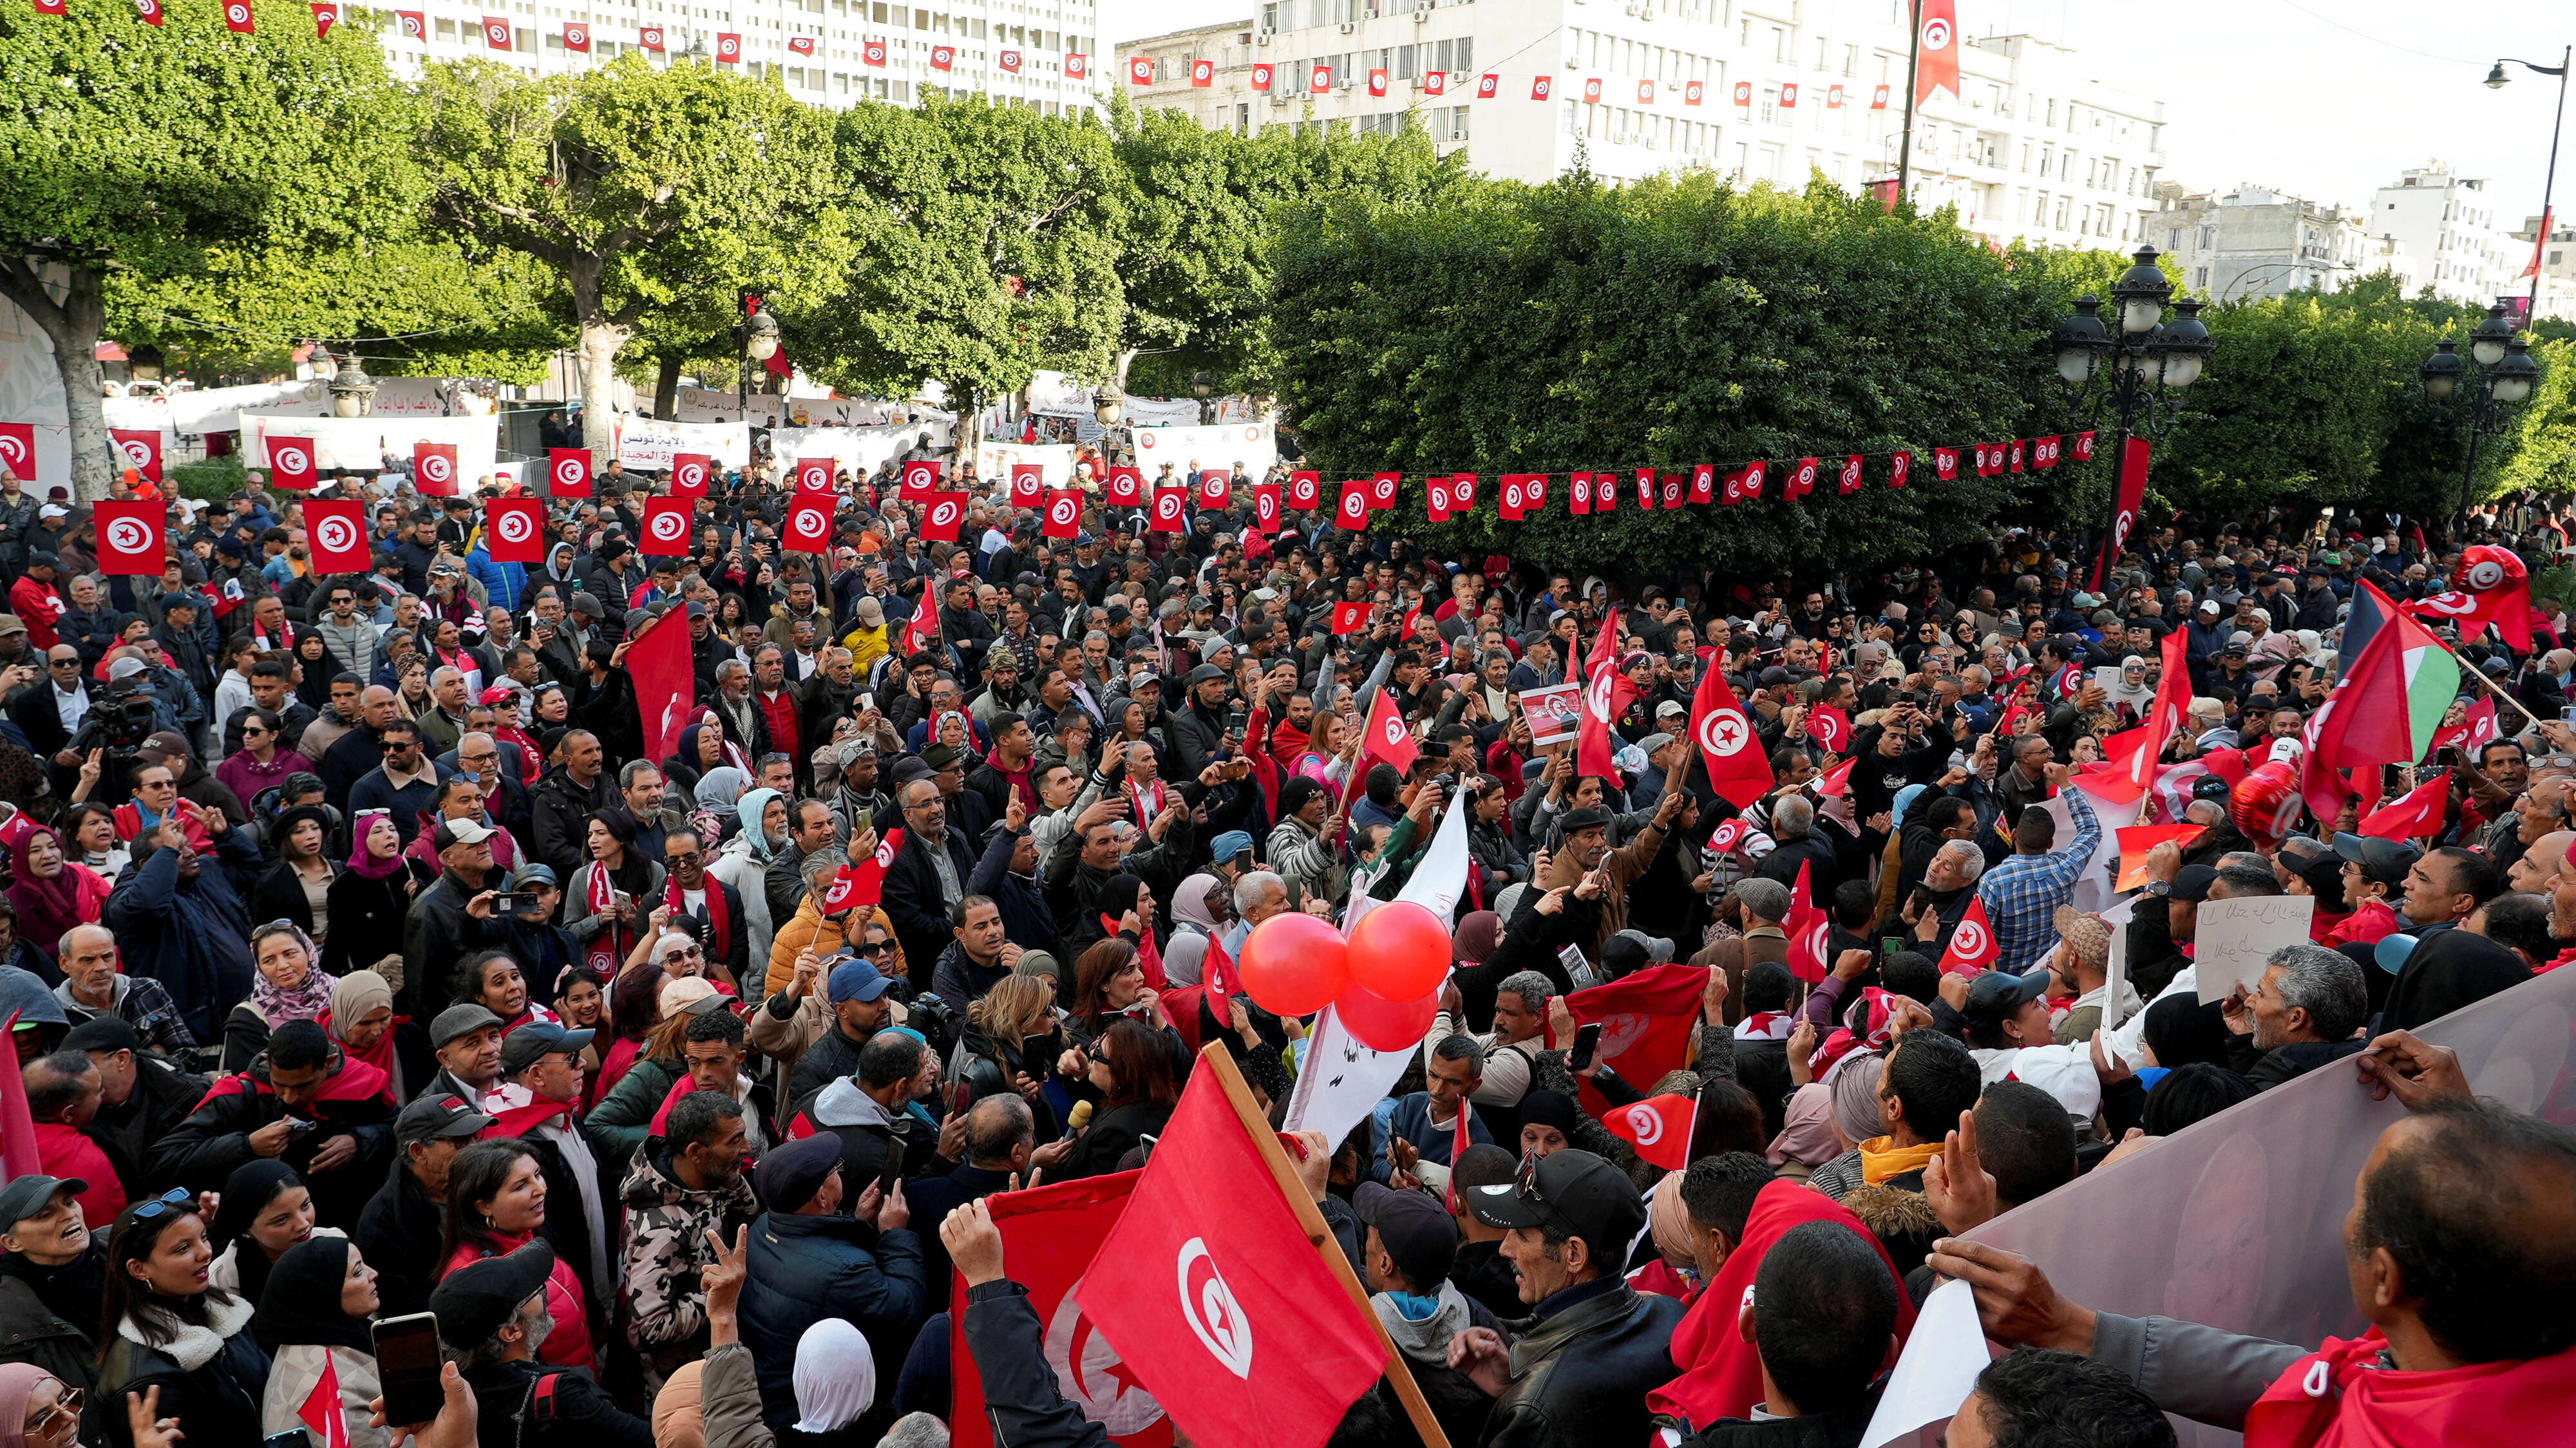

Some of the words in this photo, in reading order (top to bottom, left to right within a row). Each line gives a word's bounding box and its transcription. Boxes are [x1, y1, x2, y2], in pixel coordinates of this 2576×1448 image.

[623, 433, 654, 445] تونس
[658, 435, 685, 447] ولاية
[620, 448, 658, 462] المجيدة
